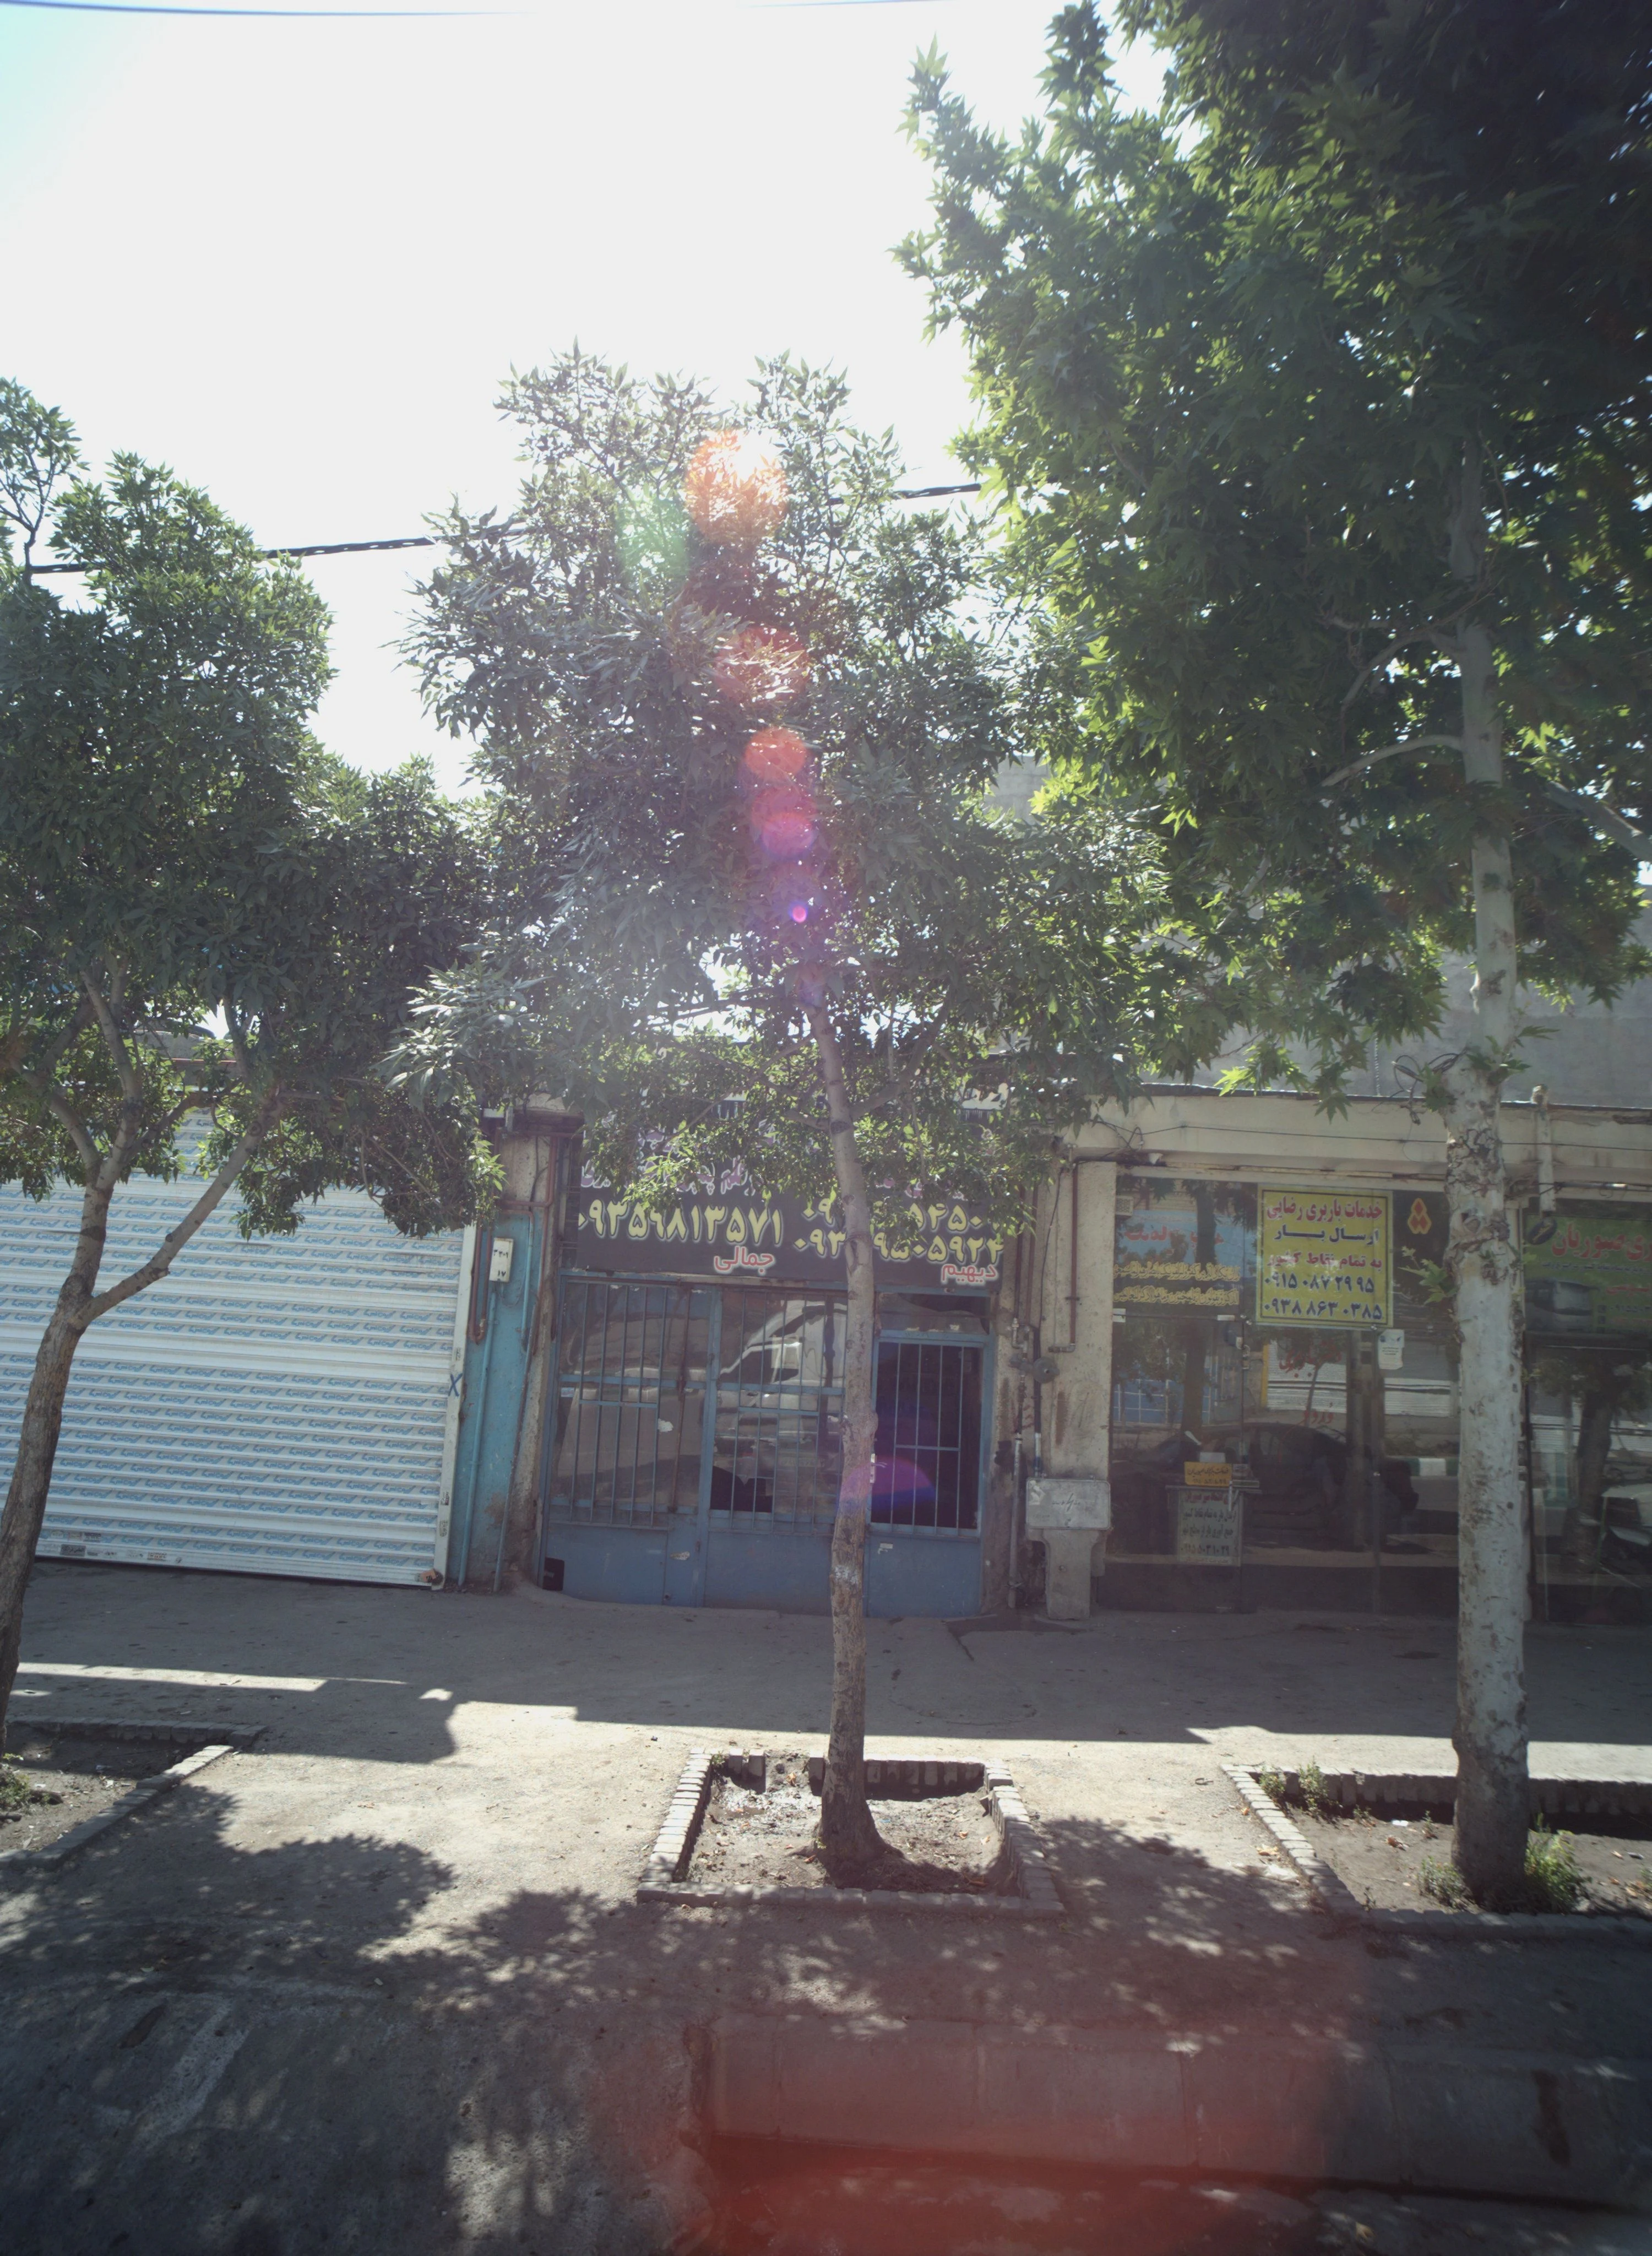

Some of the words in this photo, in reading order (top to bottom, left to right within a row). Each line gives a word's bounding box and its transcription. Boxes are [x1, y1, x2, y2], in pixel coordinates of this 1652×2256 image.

[1267, 1196, 1303, 1221] رضایی
[1306, 1198, 1342, 1223] باربری
[1344, 1200, 1383, 1219] خدمات
[794, 1228, 1004, 1264] ۰۹۳۹۵۰۵۹۲۴
[1329, 1227, 1379, 1245] ارسال
[714, 1246, 775, 1274] جمالی
[1339, 1255, 1367, 1269] تمام
[1370, 1258, 1383, 1272] به
[941, 1263, 998, 1283] دیهیم
